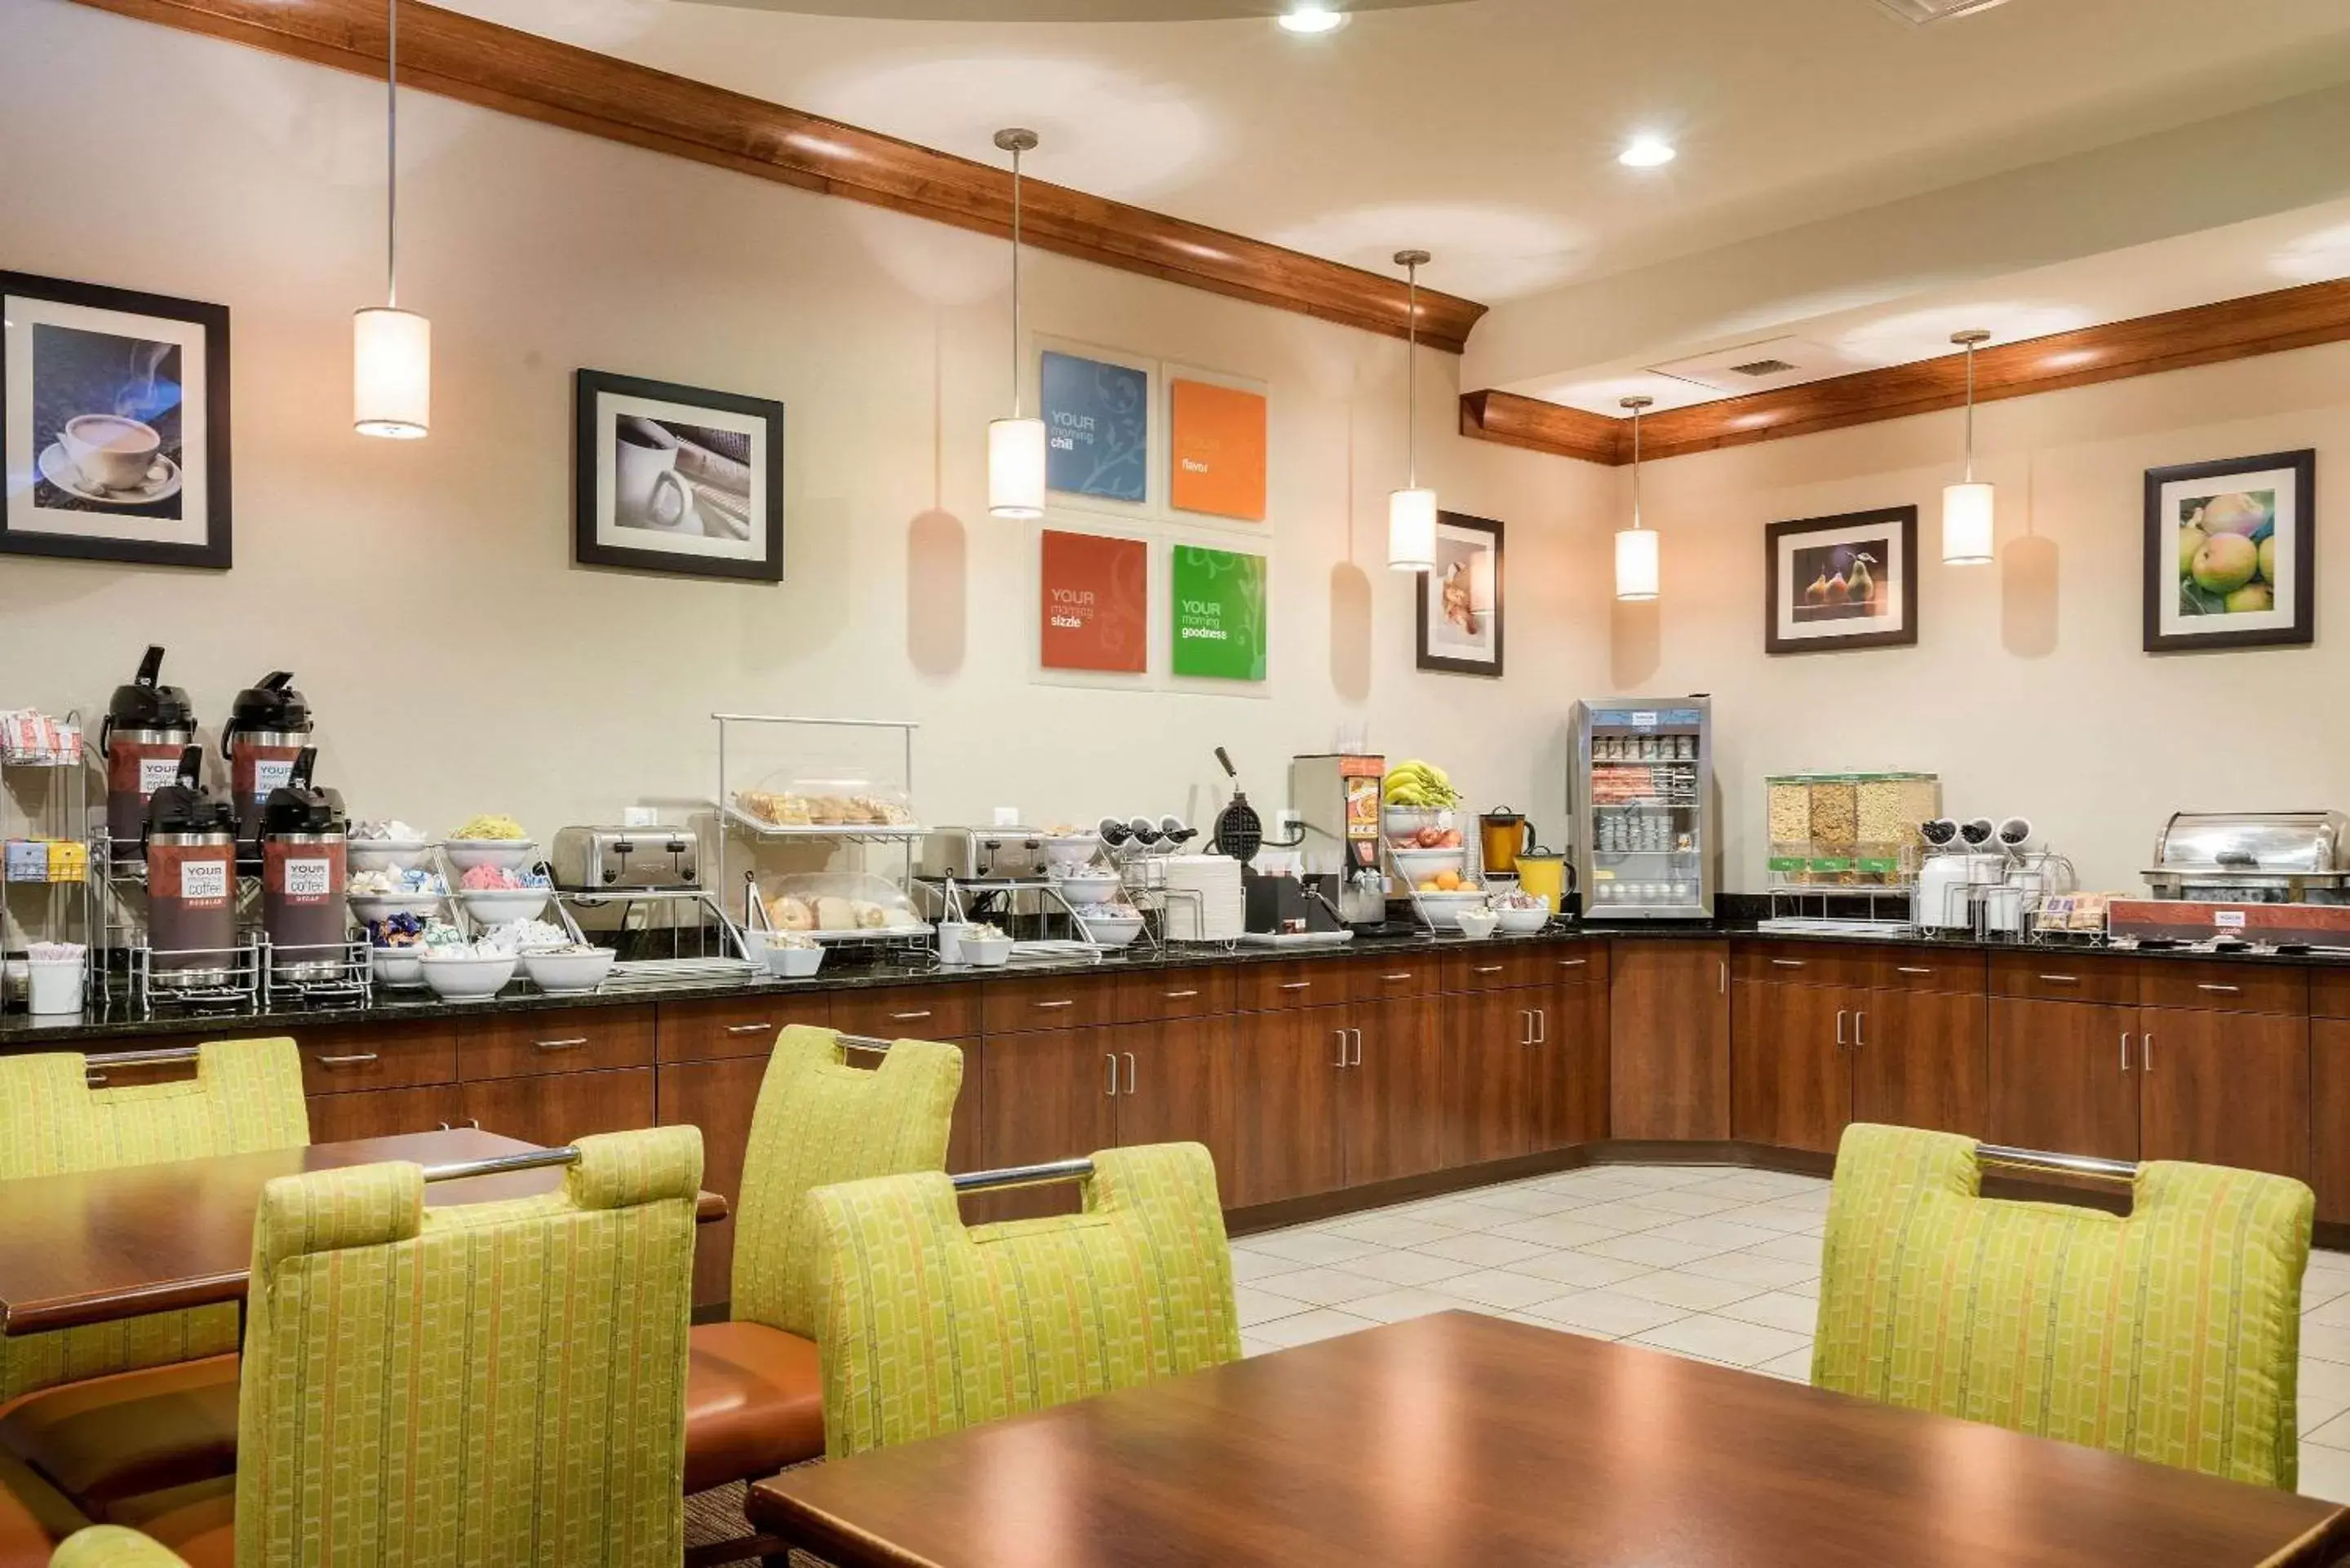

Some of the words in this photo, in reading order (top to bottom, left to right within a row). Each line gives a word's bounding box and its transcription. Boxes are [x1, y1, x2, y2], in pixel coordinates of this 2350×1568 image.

[1052, 410, 1094, 431] YOUR
[1050, 437, 1073, 450] chill
[1051, 588, 1094, 605] YOUR
[1182, 600, 1221, 616] YOUR
[1050, 615, 1082, 627] sizzle
[1182, 627, 1228, 640] goodness
[188, 866, 222, 875] YOUR
[290, 865, 325, 874] YOUR
